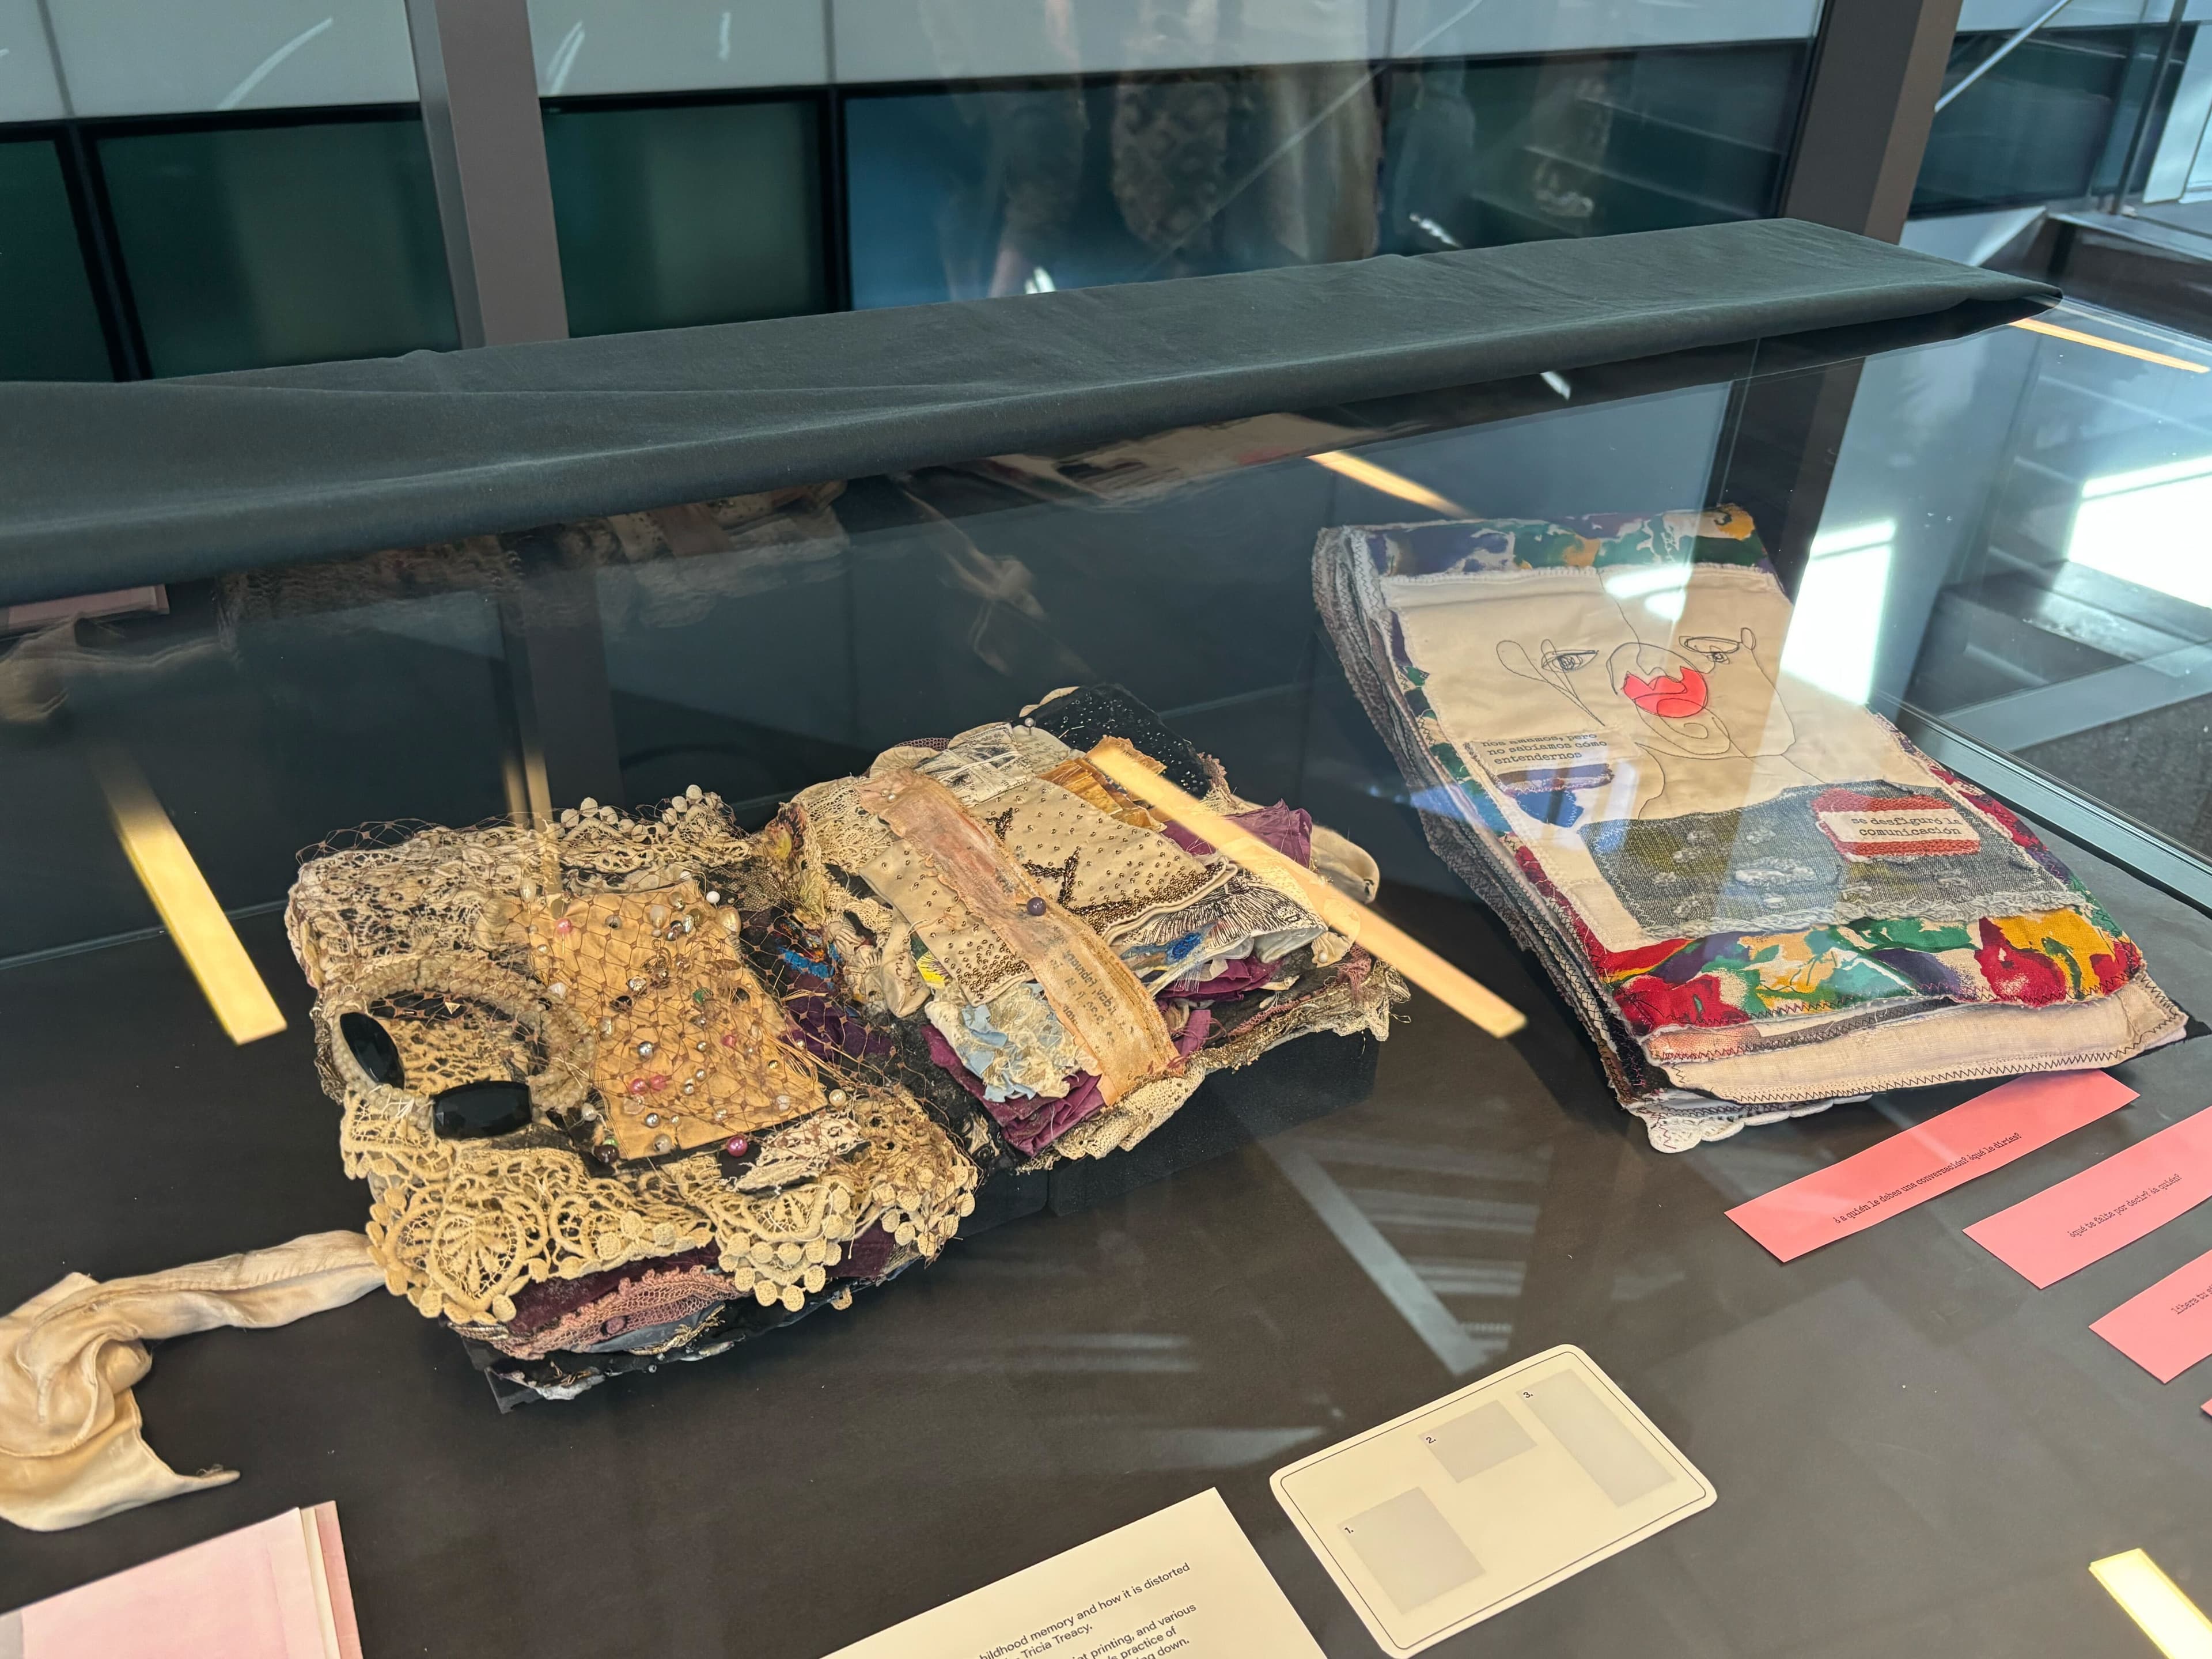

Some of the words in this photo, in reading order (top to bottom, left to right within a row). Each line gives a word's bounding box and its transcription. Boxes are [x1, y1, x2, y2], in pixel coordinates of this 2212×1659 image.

[1509, 736, 1563, 745] amamos,
[1566, 733, 1597, 742] pero
[1509, 743, 1572, 752] sabíamos
[1494, 751, 1582, 764] entendernos
[1859, 827, 1962, 836] comunicación
[1870, 817, 1943, 826] desfiguró
[1846, 1205, 1872, 1219] quién
[1878, 1190, 1903, 1202] debes
[1900, 1182, 1918, 1192] una
[1916, 1157, 1969, 1185] conversación?
[1967, 1149, 1986, 1161] ¿qué
[1993, 1132, 2022, 1149] dirías?
[2093, 1211, 2116, 1224] falta
[2113, 1205, 2128, 1215] por
[2126, 1190, 2152, 1207] decir?
[2158, 1173, 2183, 1191] quién?
[979, 1635, 1028, 1659] ildhood
[1030, 1616, 1074, 1641] memory
[1076, 1604, 1097, 1620] and
[1097, 1594, 1122, 1609] how
[1122, 1590, 1132, 1599] it
[1131, 1586, 1143, 1594] is
[1143, 1562, 1191, 1589] distorted
[1020, 1642, 1052, 1658] Tricia
[1051, 1623, 1093, 1645] Treacy.
[1090, 1635, 1135, 1659] printing,
[1136, 1620, 1157, 1636] and
[1157, 1604, 1197, 1626] various
[1120, 1634, 1164, 1659] practice
[1165, 1626, 1176, 1637] of
[1157, 1638, 1190, 1656] down.
